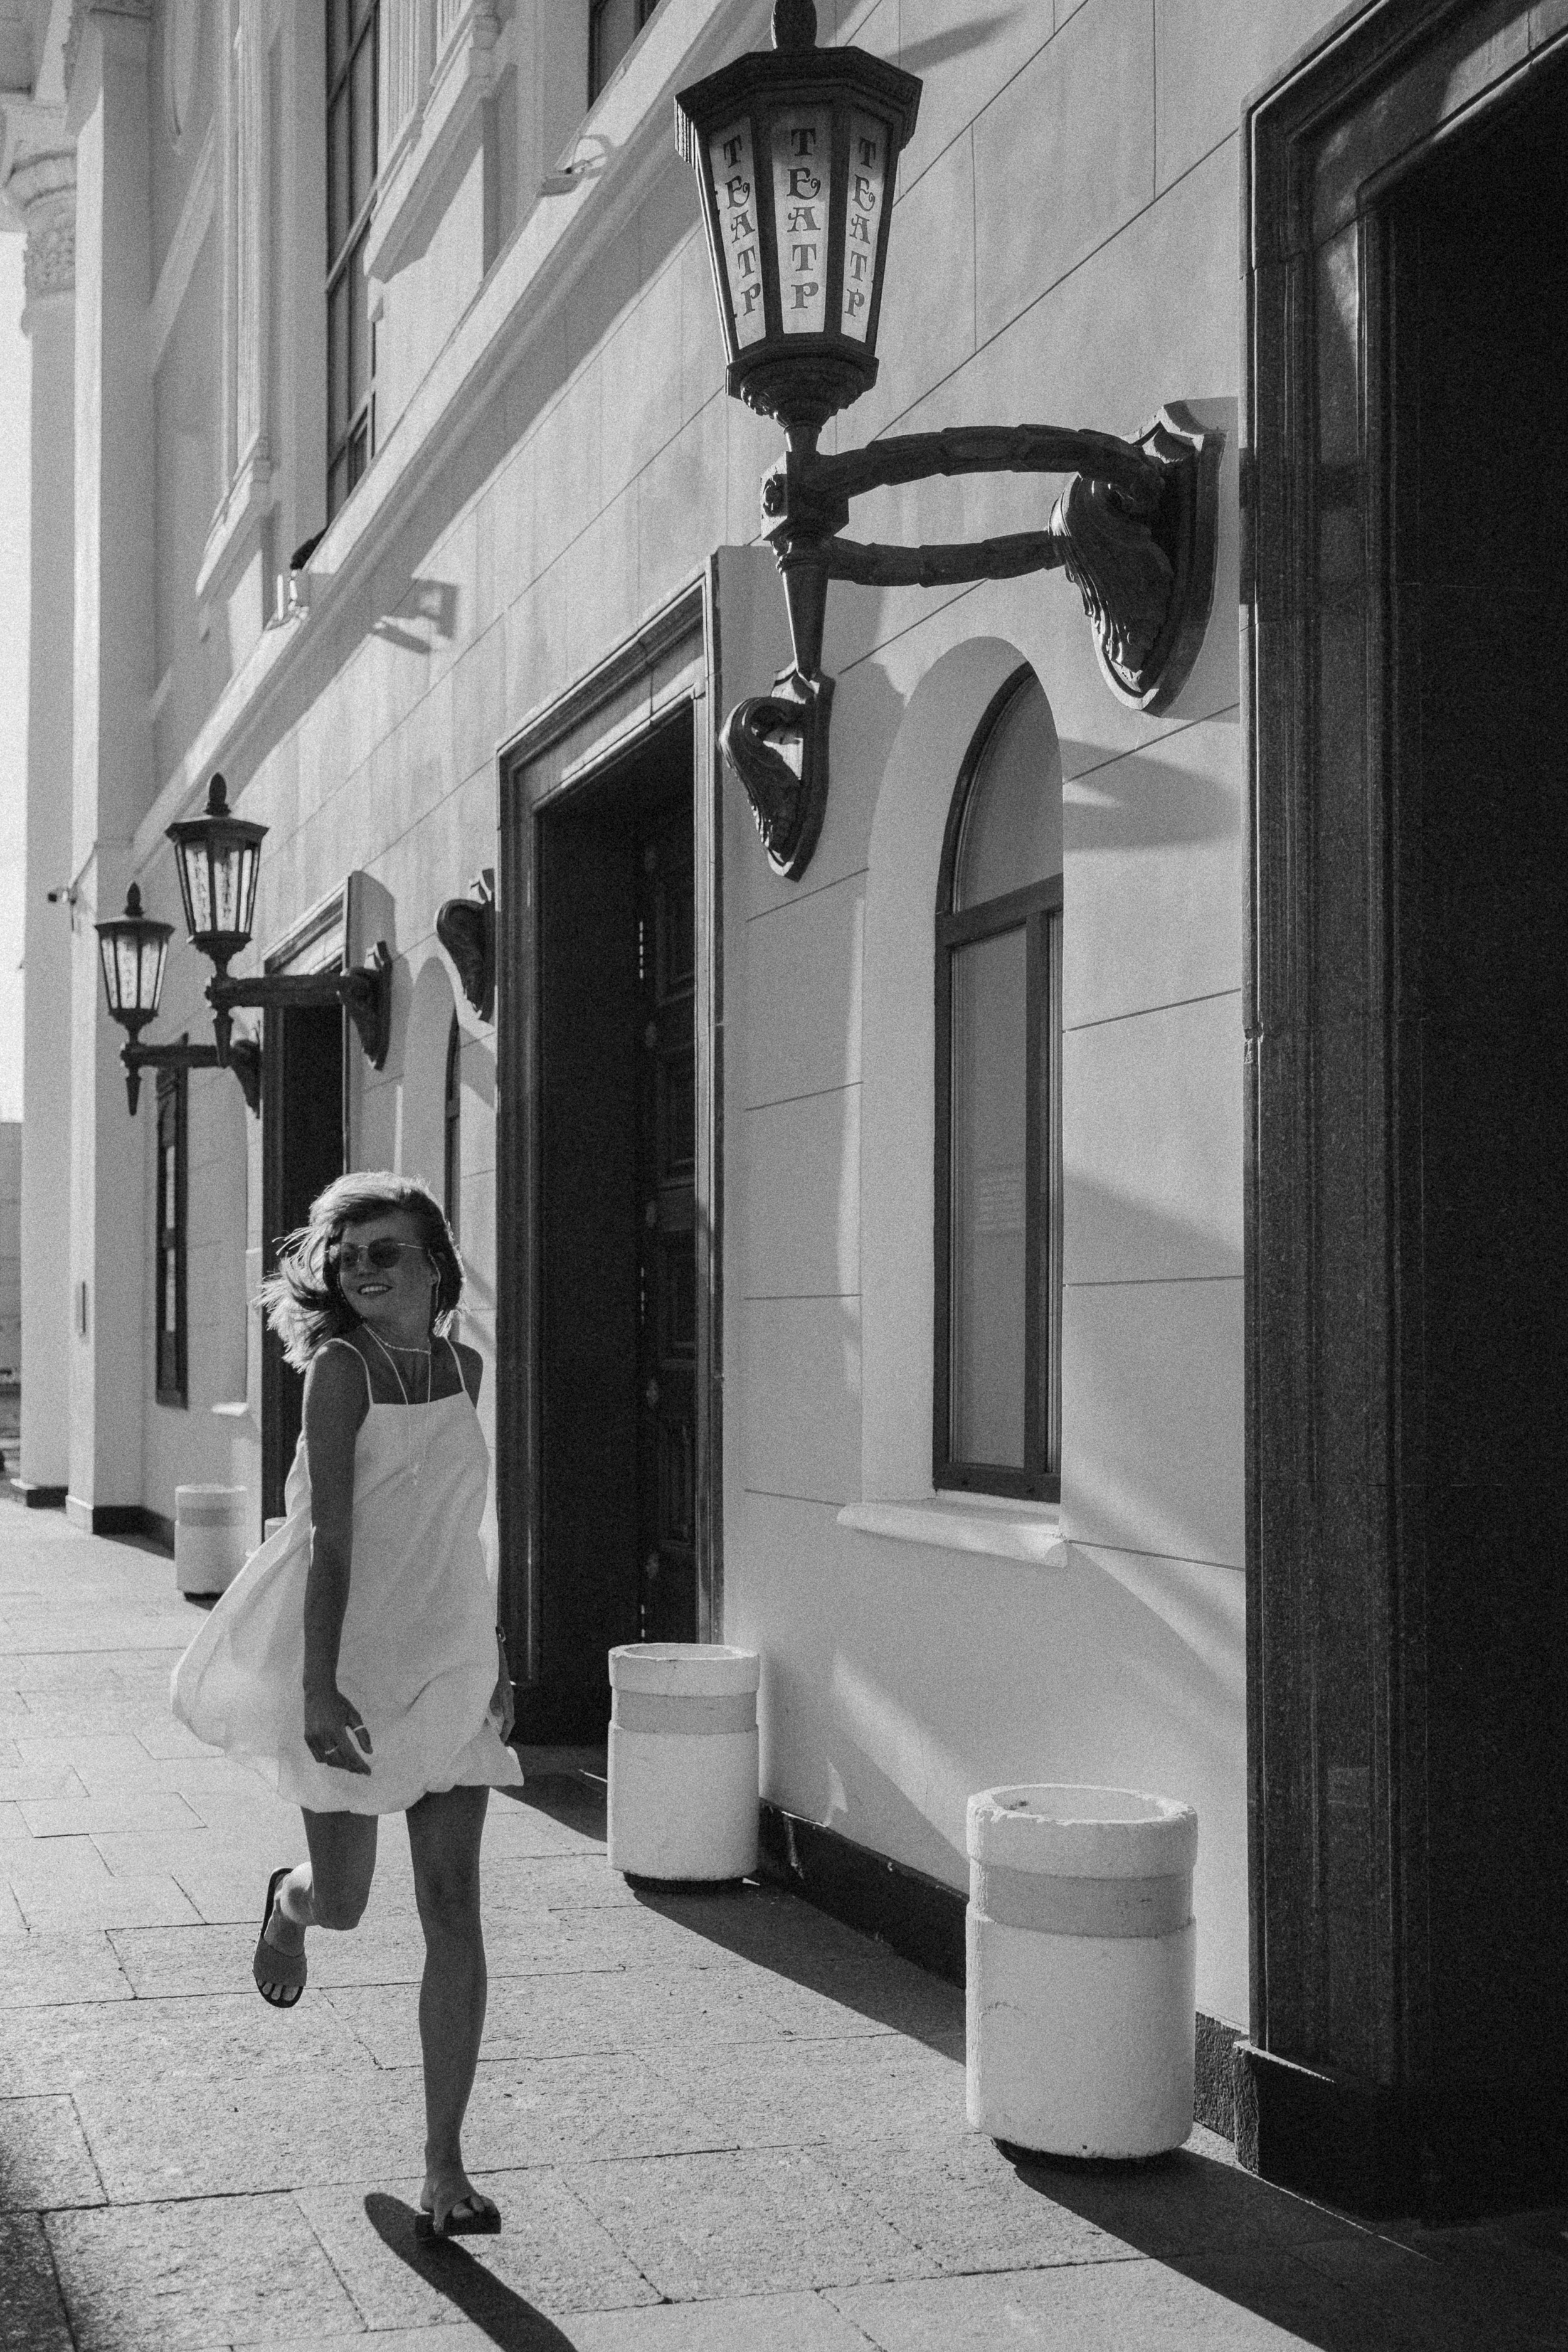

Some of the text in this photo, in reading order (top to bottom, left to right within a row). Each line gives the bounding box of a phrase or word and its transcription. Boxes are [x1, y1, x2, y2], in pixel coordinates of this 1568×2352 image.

[723, 135, 761, 316] ТЕАТР
[787, 128, 821, 309] ТЕАТР
[844, 138, 876, 317] ТЕАТР
